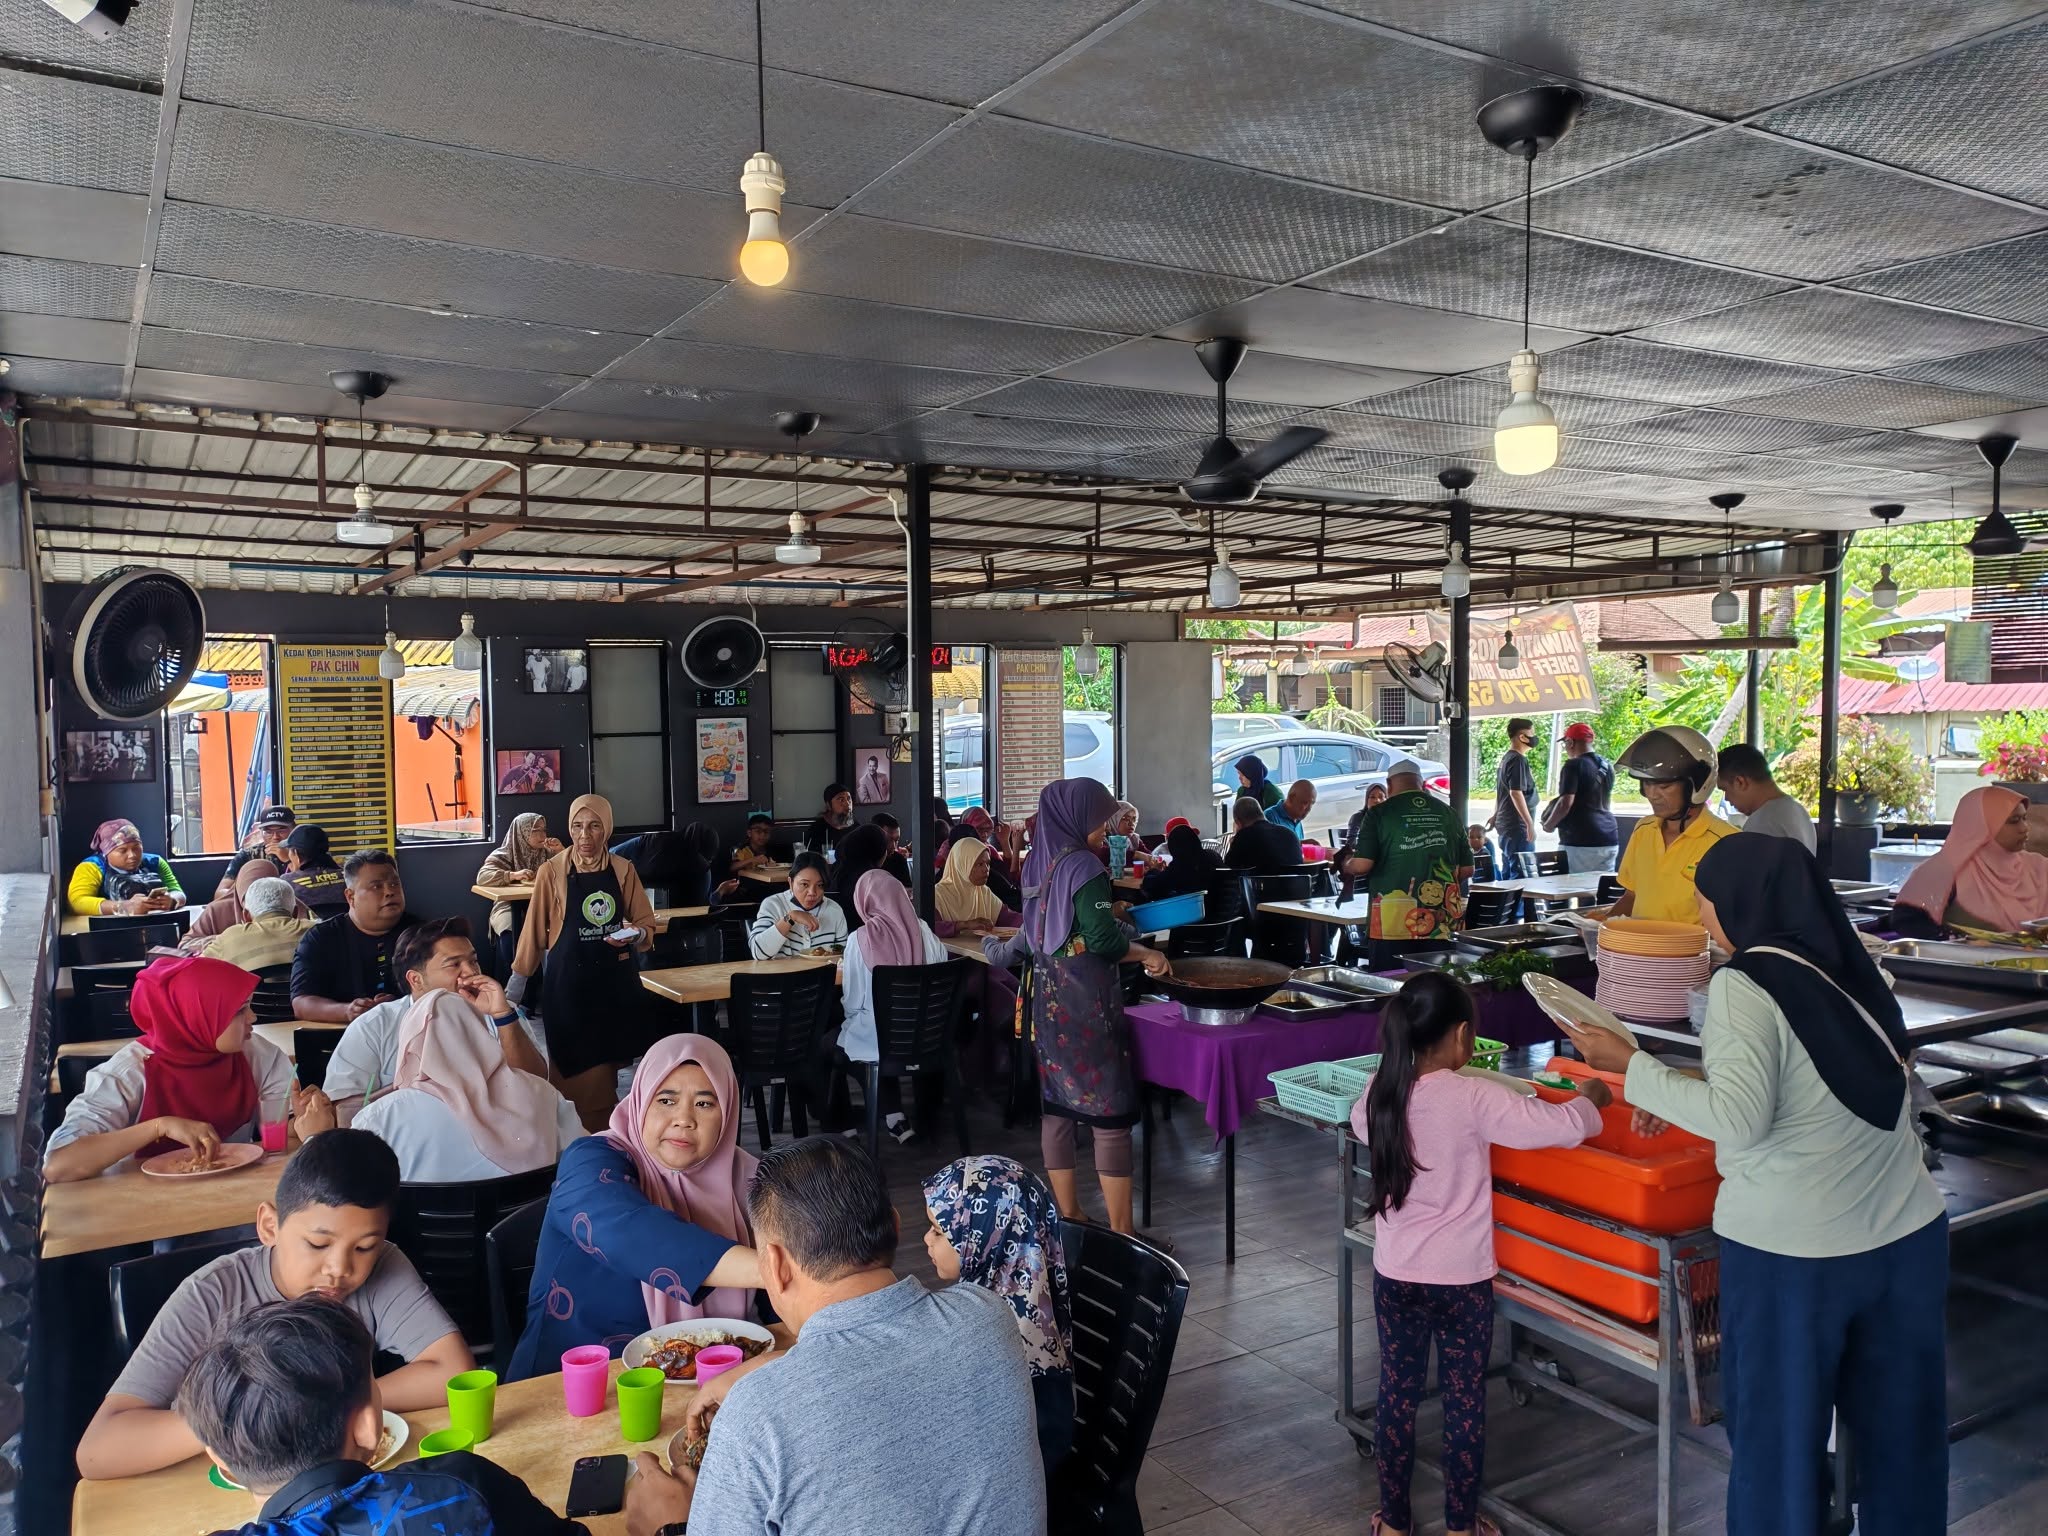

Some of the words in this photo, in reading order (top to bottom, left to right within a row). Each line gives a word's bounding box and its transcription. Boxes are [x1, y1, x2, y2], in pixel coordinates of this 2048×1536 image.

[283, 648, 304, 658] KEDAI
[307, 648, 323, 658] KOPI
[325, 648, 354, 658] HASHIM
[310, 660, 331, 672] PAK
[334, 660, 360, 672] CHIN
[1016, 663, 1029, 673] PAK
